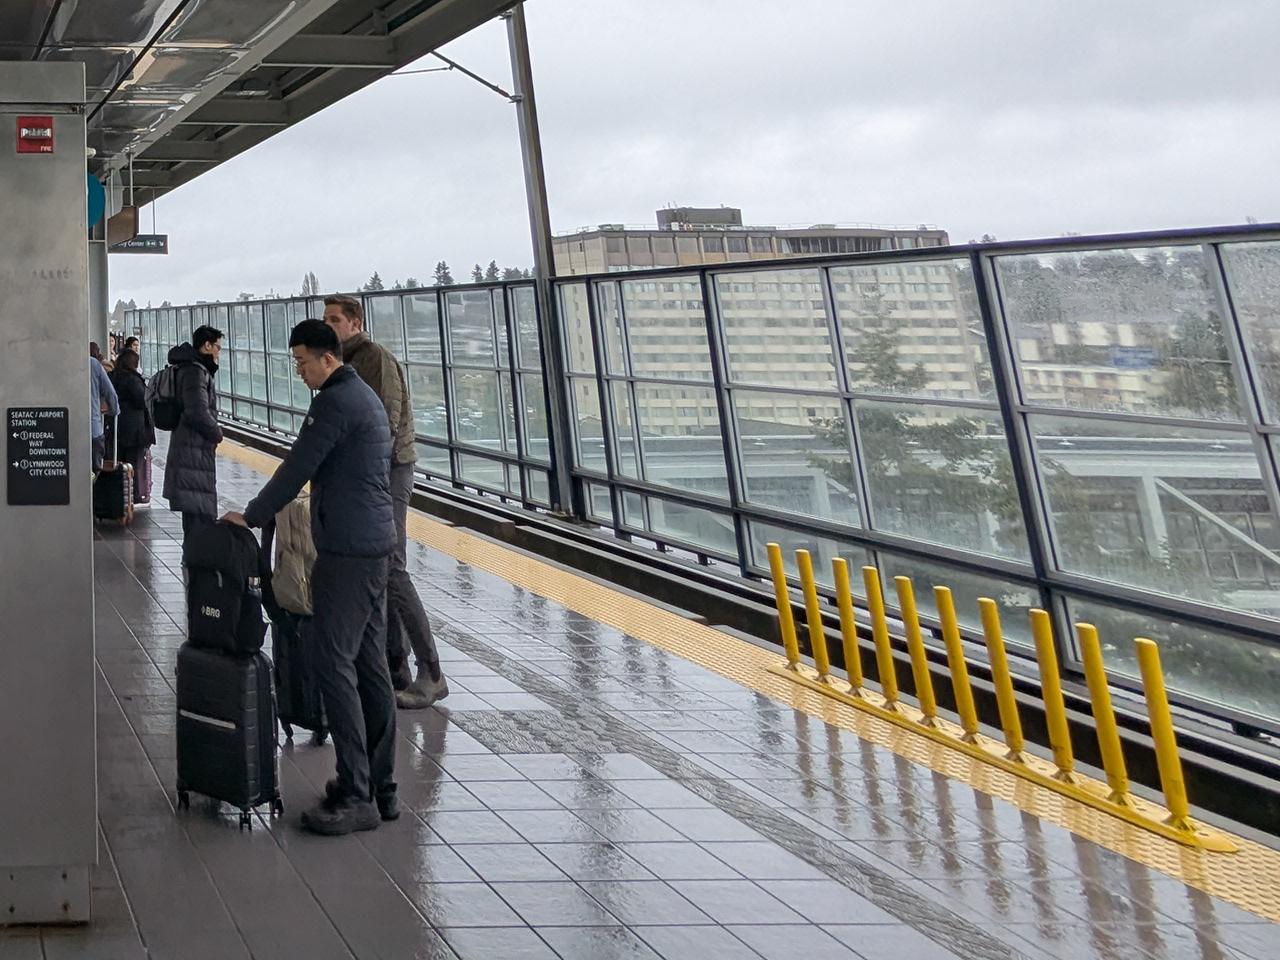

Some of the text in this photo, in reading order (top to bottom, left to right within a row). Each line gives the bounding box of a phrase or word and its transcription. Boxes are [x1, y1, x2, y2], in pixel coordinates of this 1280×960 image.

[11, 419, 37, 427] STATION
[29, 448, 66, 456] DOWNTOWN
[29, 460, 65, 468] LYNNWOOD
[29, 468, 67, 477] CITY CENTER
